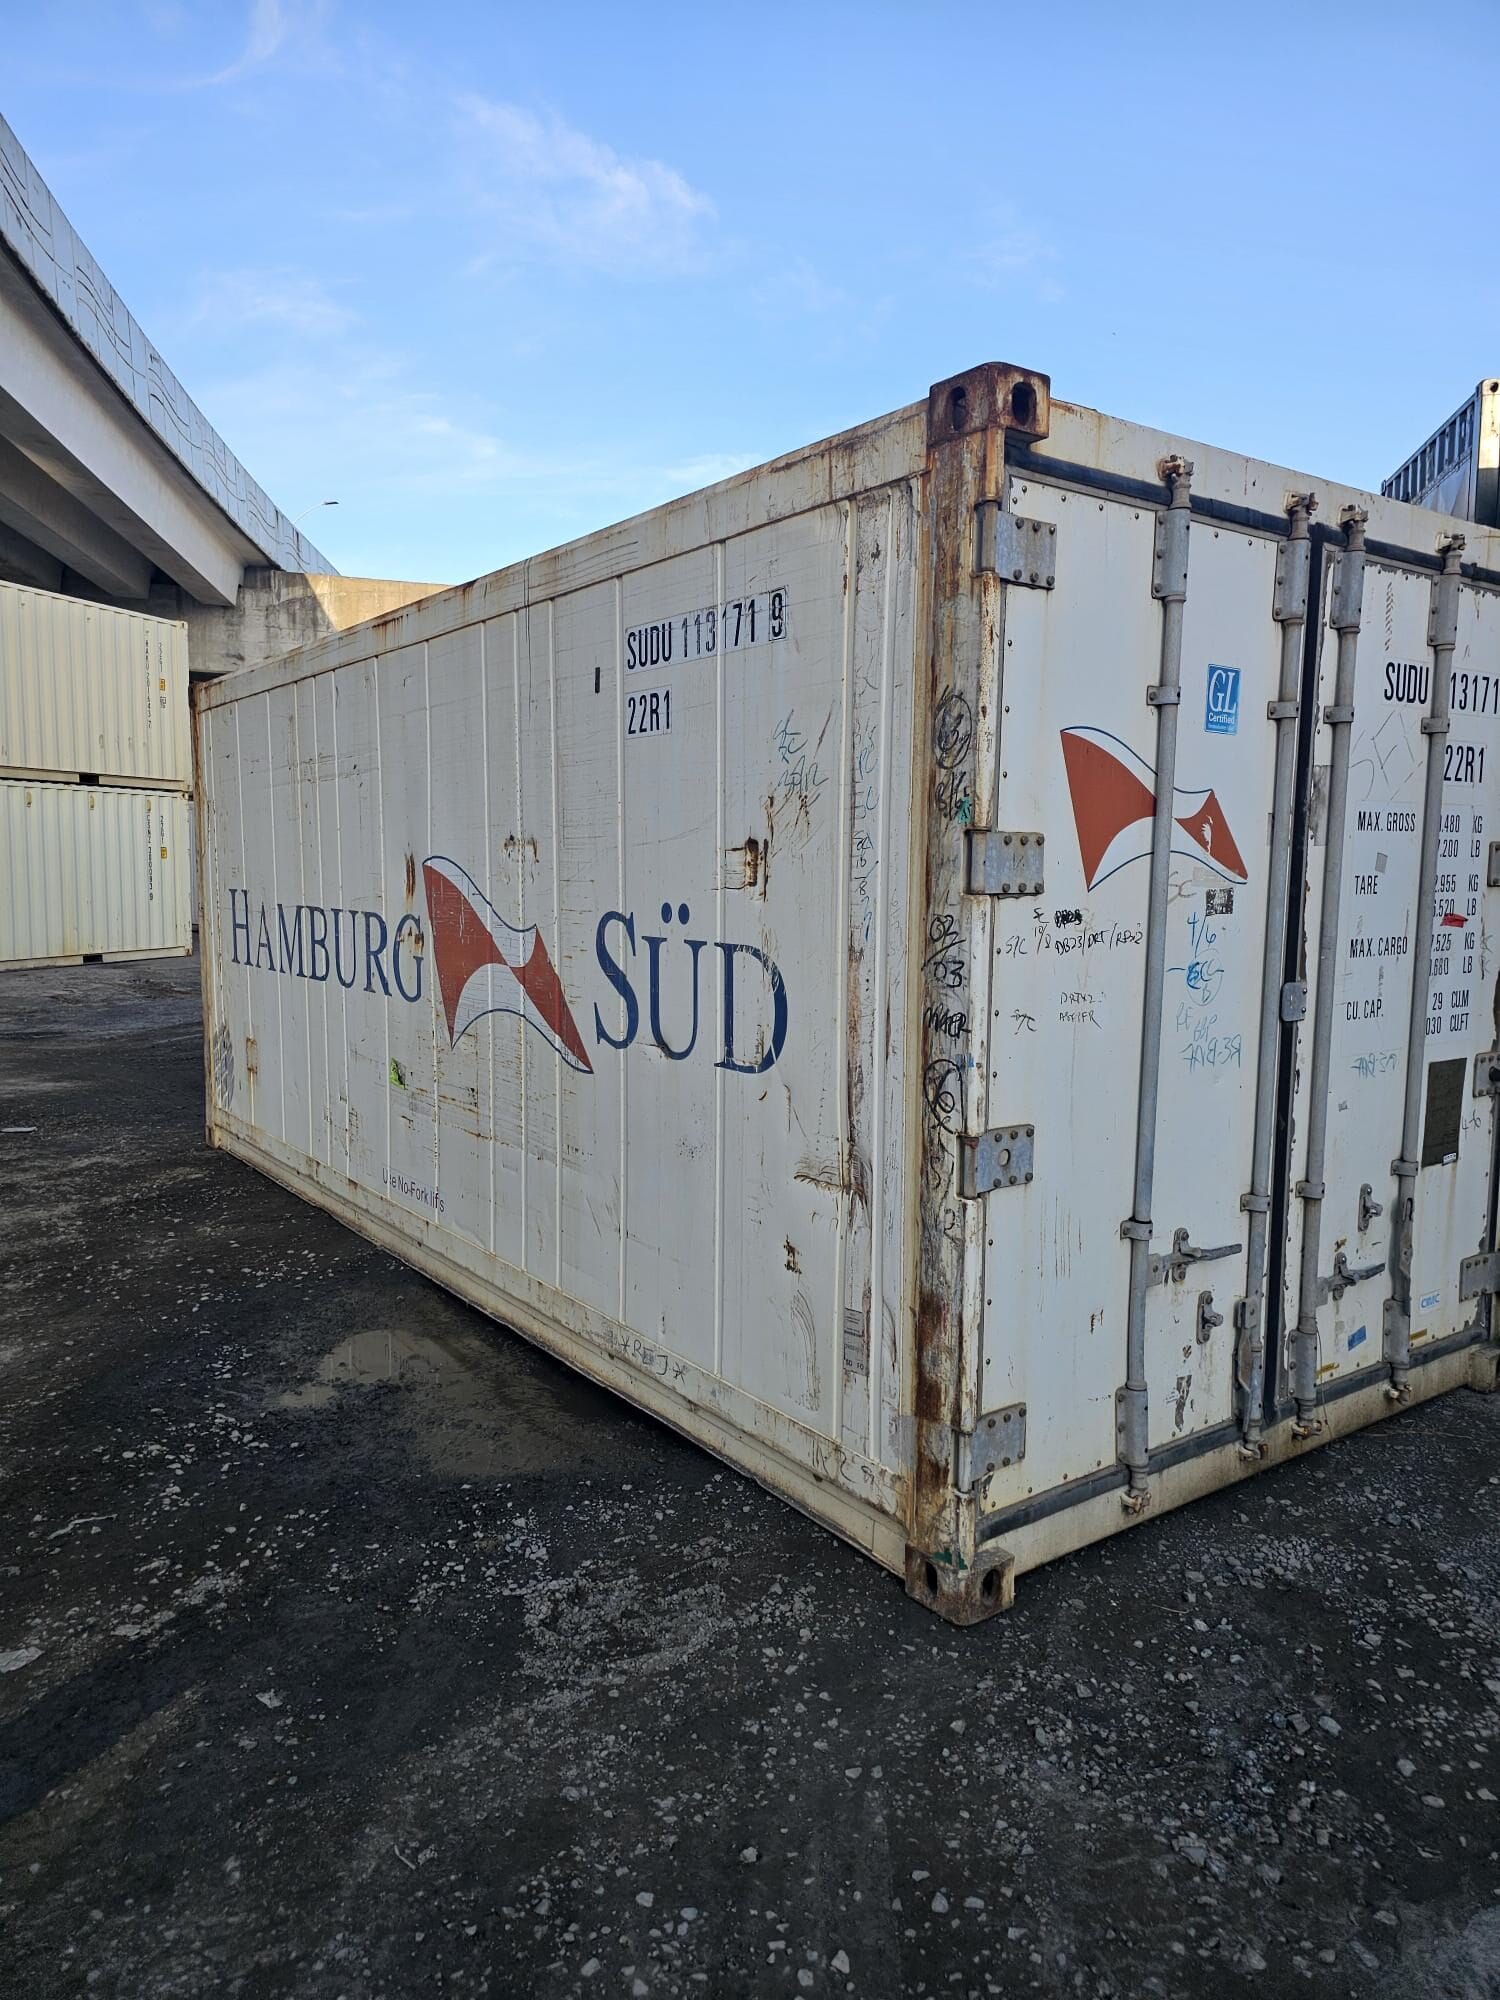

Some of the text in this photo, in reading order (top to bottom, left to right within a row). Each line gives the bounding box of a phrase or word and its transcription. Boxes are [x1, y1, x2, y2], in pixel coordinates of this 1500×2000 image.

[626, 621, 672, 670] SUDU
[681, 599, 757, 658] 113171
[1208, 669, 1236, 714] GL
[1384, 661, 1500, 715] SUDU 13171
[627, 689, 671, 735] 22R1
[1208, 712, 1235, 724] Certified
[1443, 744, 1485, 784] 22R1
[1357, 810, 1483, 834] MAX. GROSS .480 KG
[1438, 839, 1481, 858] .200 LB
[1354, 874, 1479, 895] TARE 2.955 KG
[1466, 898, 1477, 916] LB
[1350, 931, 1475, 959] MAX. CARGO .525 KG
[1429, 955, 1473, 976] .680 LB
[228, 888, 788, 1074] HAMBURG SÜD
[1346, 1001, 1361, 1021] CU.
[1363, 998, 1384, 1018] CAP.
[1432, 992, 1443, 1011] 29
[1425, 1016, 1442, 1036] 030
